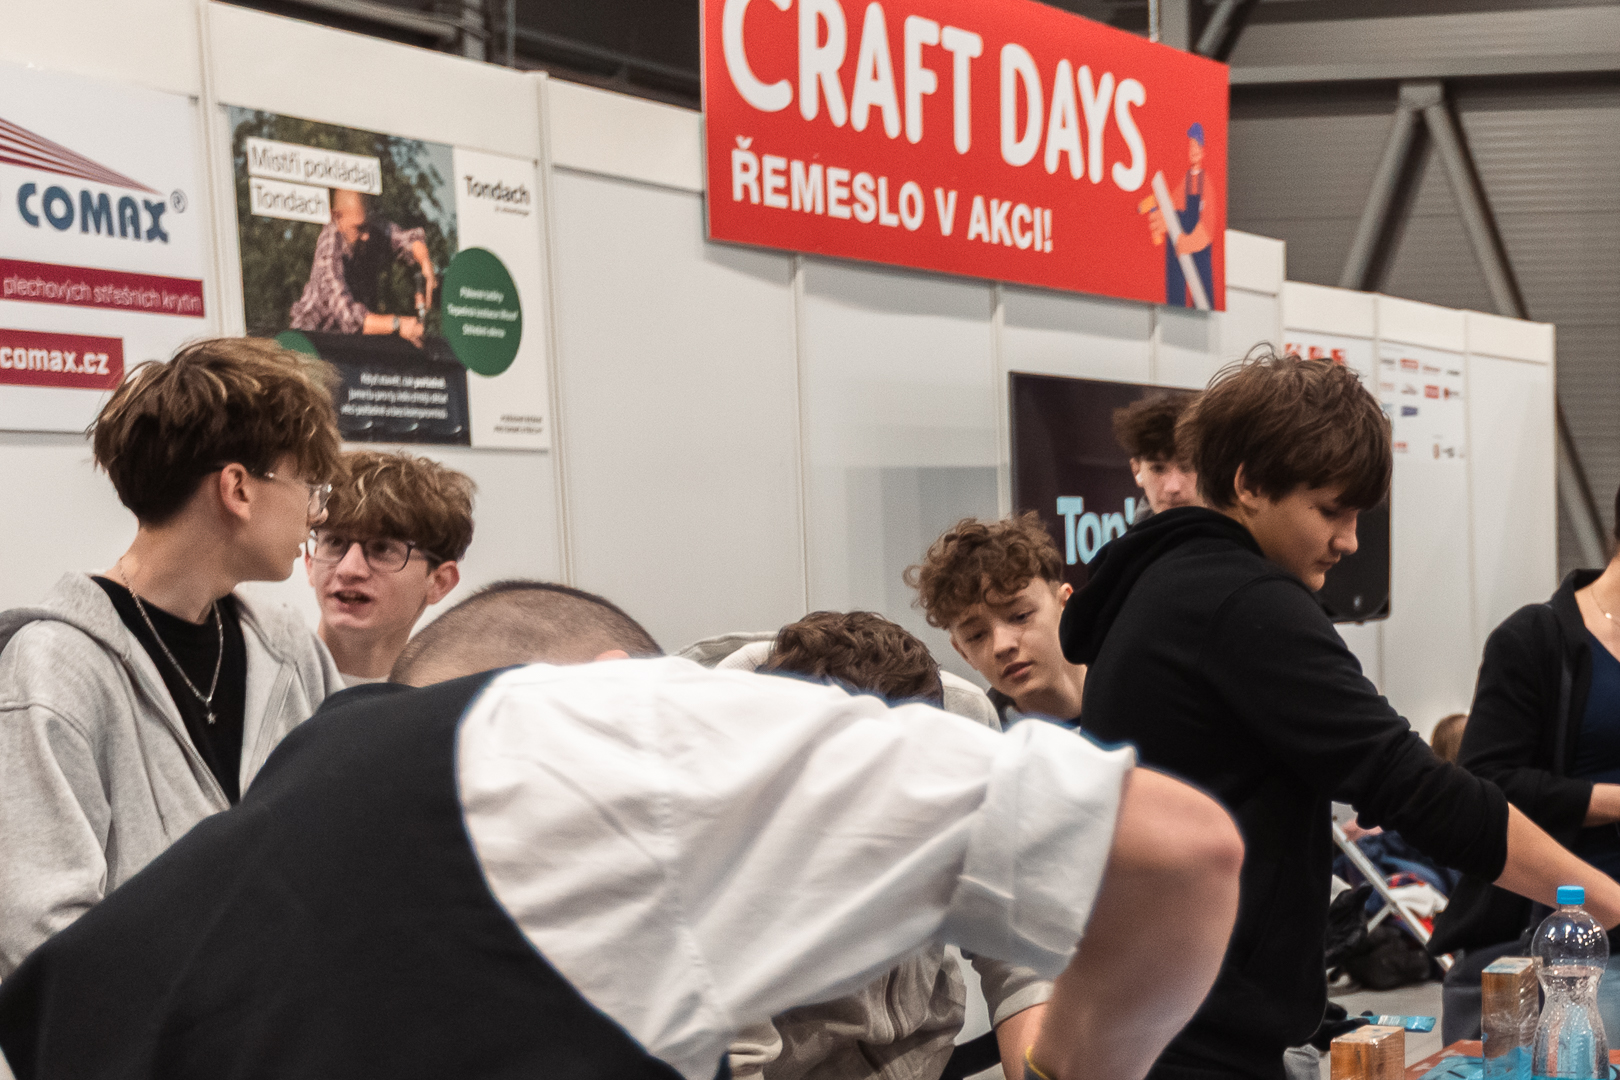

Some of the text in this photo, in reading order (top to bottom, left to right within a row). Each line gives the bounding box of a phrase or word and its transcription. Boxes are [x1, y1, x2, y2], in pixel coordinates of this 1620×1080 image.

[722, 0, 1147, 192] CRAFT DAYS
[254, 185, 324, 216] Tondach
[463, 174, 531, 205] Tondach
[731, 136, 1054, 253] ŘEMESLO V AKCI!
[0, 346, 110, 375] comax.cz
